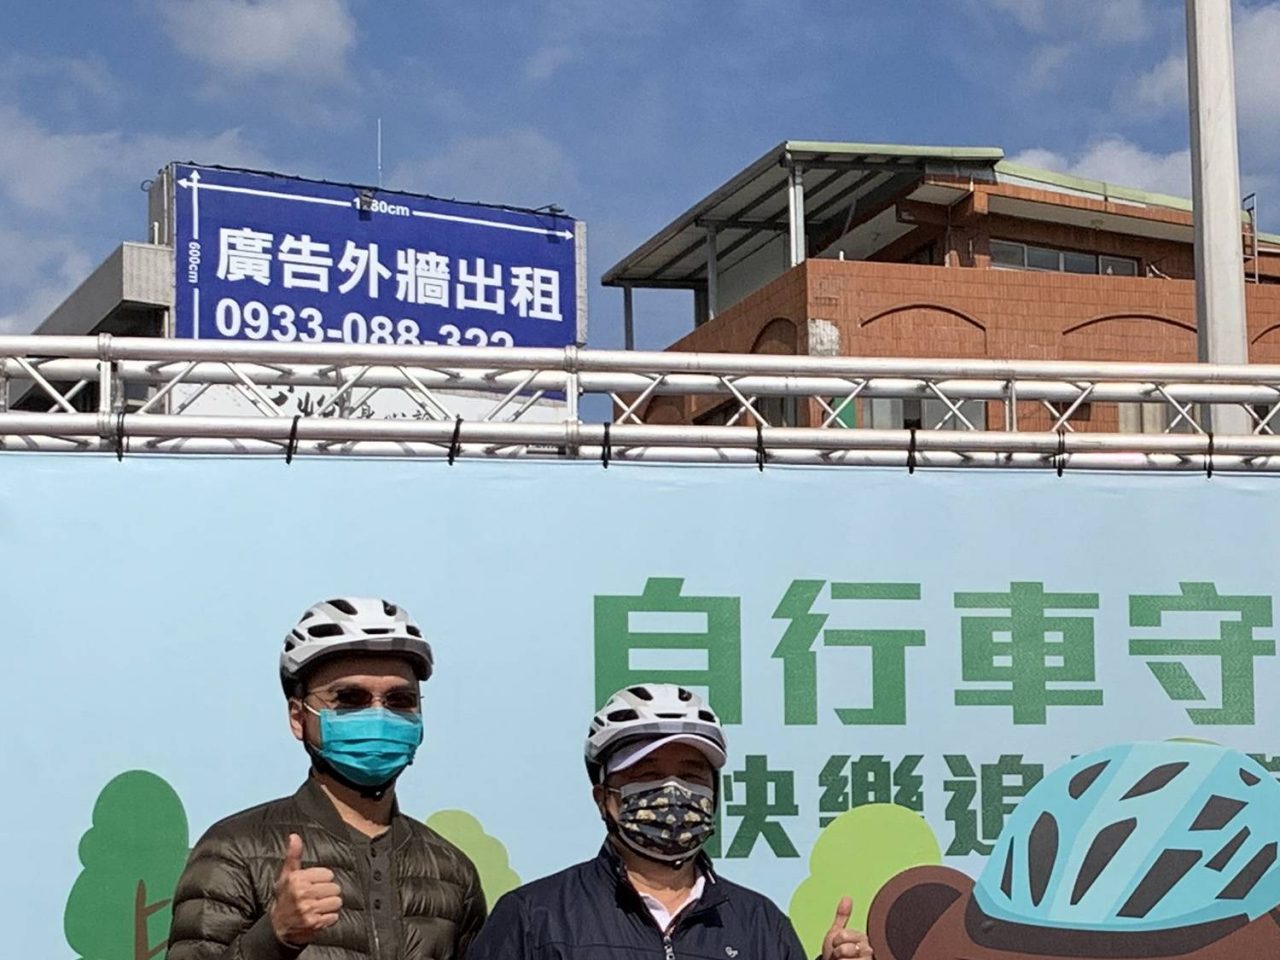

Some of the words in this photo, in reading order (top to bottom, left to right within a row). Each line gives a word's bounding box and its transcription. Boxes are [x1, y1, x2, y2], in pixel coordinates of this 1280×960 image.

[353, 197, 410, 217] 180cm
[188, 241, 201, 284] 600cm
[216, 227, 563, 322] 廣告外牆出租
